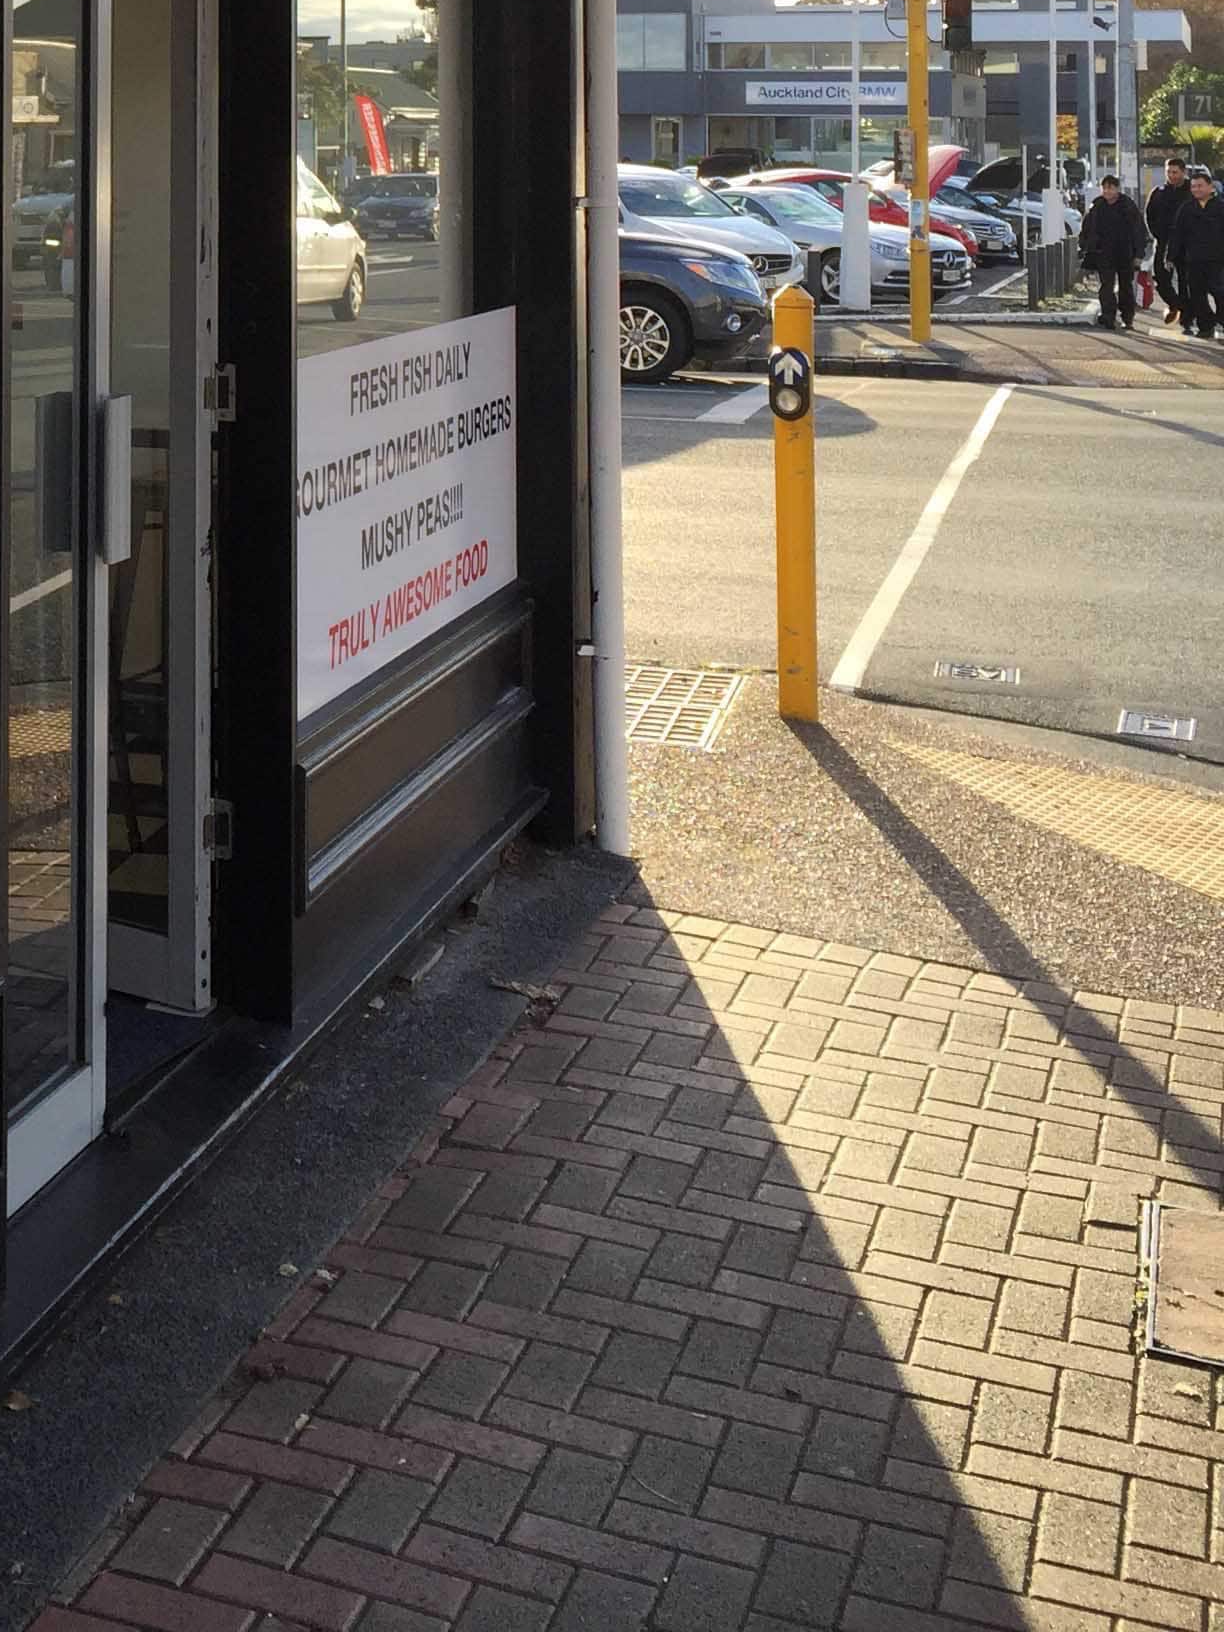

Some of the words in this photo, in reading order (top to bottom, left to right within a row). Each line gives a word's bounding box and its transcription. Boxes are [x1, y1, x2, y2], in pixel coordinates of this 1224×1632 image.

[758, 86, 823, 99] Auckland
[826, 86, 853, 101] City
[859, 86, 896, 97] BMW
[350, 362, 399, 417] FRESH
[402, 351, 432, 395] FISH
[435, 340, 471, 386] DAILY
[376, 417, 455, 485] HOMEMADE
[457, 394, 512, 450] BURGERS
[361, 506, 413, 571] MUSHY
[328, 599, 382, 671] TRULY
[382, 560, 452, 637] AWESOME
[455, 538, 489, 591] FOOD
